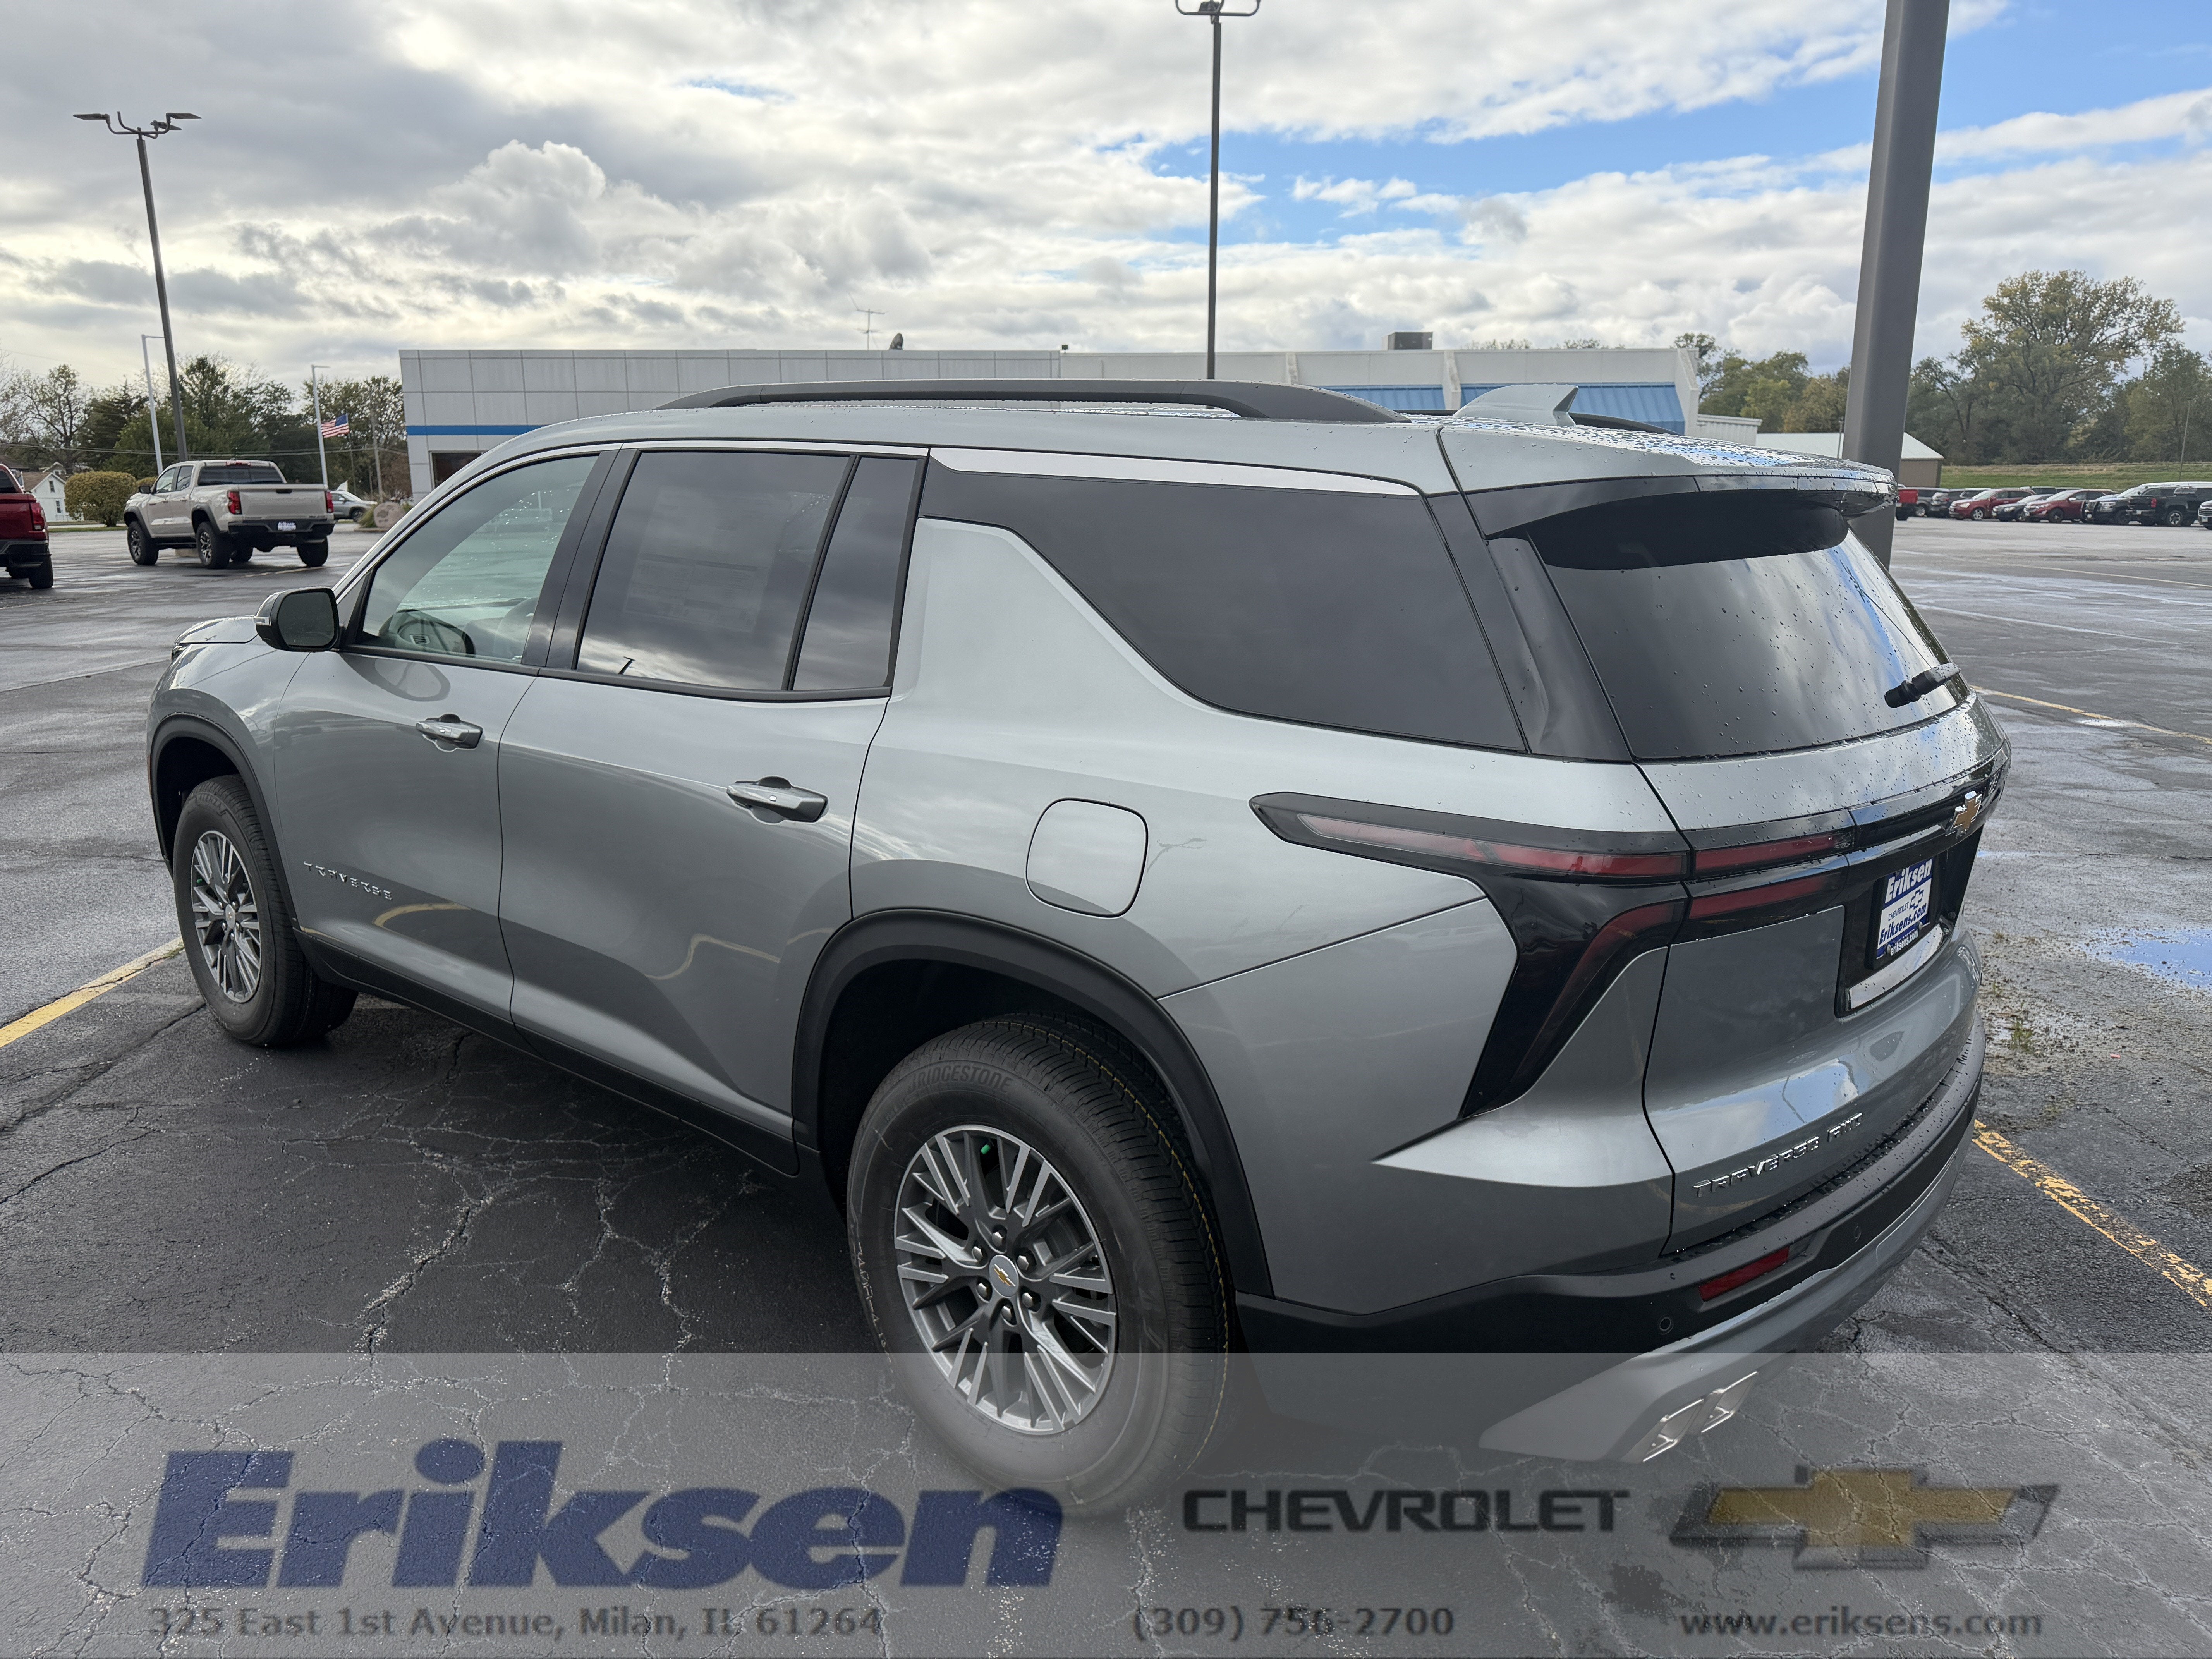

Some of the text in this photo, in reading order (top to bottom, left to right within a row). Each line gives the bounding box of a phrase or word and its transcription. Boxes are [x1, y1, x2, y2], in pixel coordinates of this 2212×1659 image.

[303, 860, 393, 900] TRAVERSE
[1885, 859, 1932, 904] Eriksen
[1879, 902, 1927, 945] Eriksens.com
[1888, 902, 1909, 921] CHEVROLET
[1890, 929, 1918, 956] eriksens.com
[1692, 1112, 1863, 1197] TRAVERSE AWD
